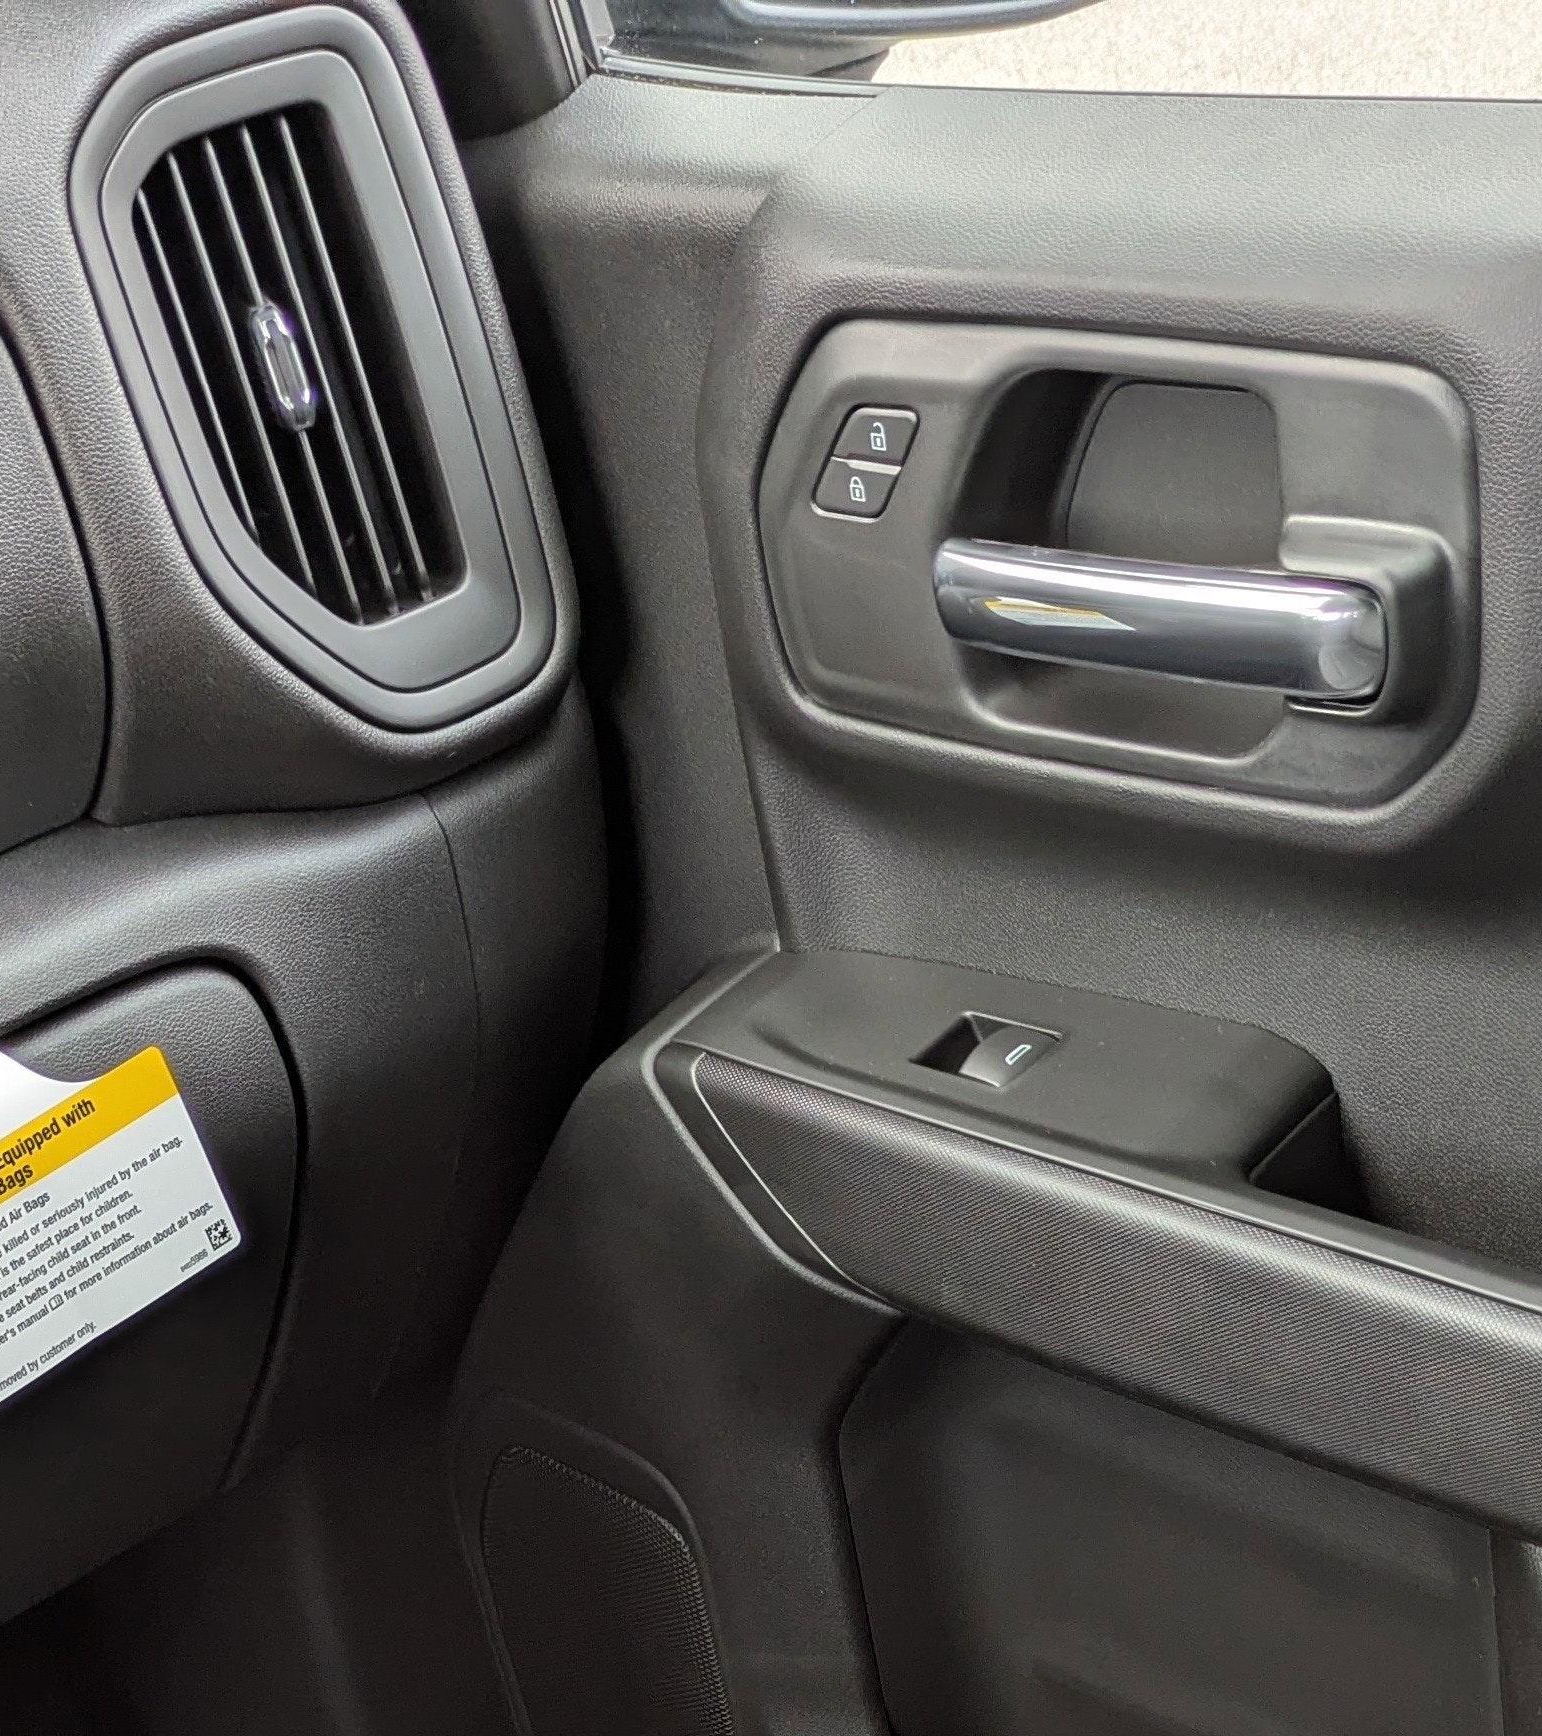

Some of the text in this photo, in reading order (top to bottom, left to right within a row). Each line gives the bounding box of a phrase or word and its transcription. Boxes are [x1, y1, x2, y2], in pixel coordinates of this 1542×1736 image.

[60, 1098, 96, 1128] with
[1, 1229, 30, 1254] killed
[29, 1222, 41, 1237] or
[41, 1196, 85, 1229] seriously
[84, 1173, 119, 1203] injured
[117, 1167, 132, 1181] by
[131, 1157, 149, 1173] the
[148, 1147, 161, 1163] air
[160, 1136, 183, 1154] bag.
[8, 1207, 23, 1225] Air
[22, 1192, 51, 1214] Bags
[9, 1256, 27, 1271] the
[25, 1235, 55, 1261] safest
[53, 1221, 81, 1246] place
[79, 1212, 94, 1227] for
[94, 1190, 134, 1218] children.
[16, 1303, 50, 1333] manual
[63, 1286, 78, 1301] for
[78, 1271, 103, 1292] more
[101, 1240, 153, 1277] information
[152, 1222, 178, 1246] about
[176, 1215, 189, 1230] air
[188, 1202, 214, 1221] bags.
[46, 1246, 71, 1269] child
[70, 1234, 92, 1255] seat
[89, 1230, 102, 1242] in
[100, 1220, 118, 1235] the
[116, 1204, 143, 1226] front.
[4, 1298, 27, 1319] seat
[24, 1285, 49, 1306] belts
[48, 1270, 67, 1290] and
[66, 1256, 90, 1278] child
[89, 1232, 135, 1265] restraints.
[26, 1359, 39, 1373] by
[39, 1333, 76, 1365] customer
[76, 1321, 97, 1339] only.
